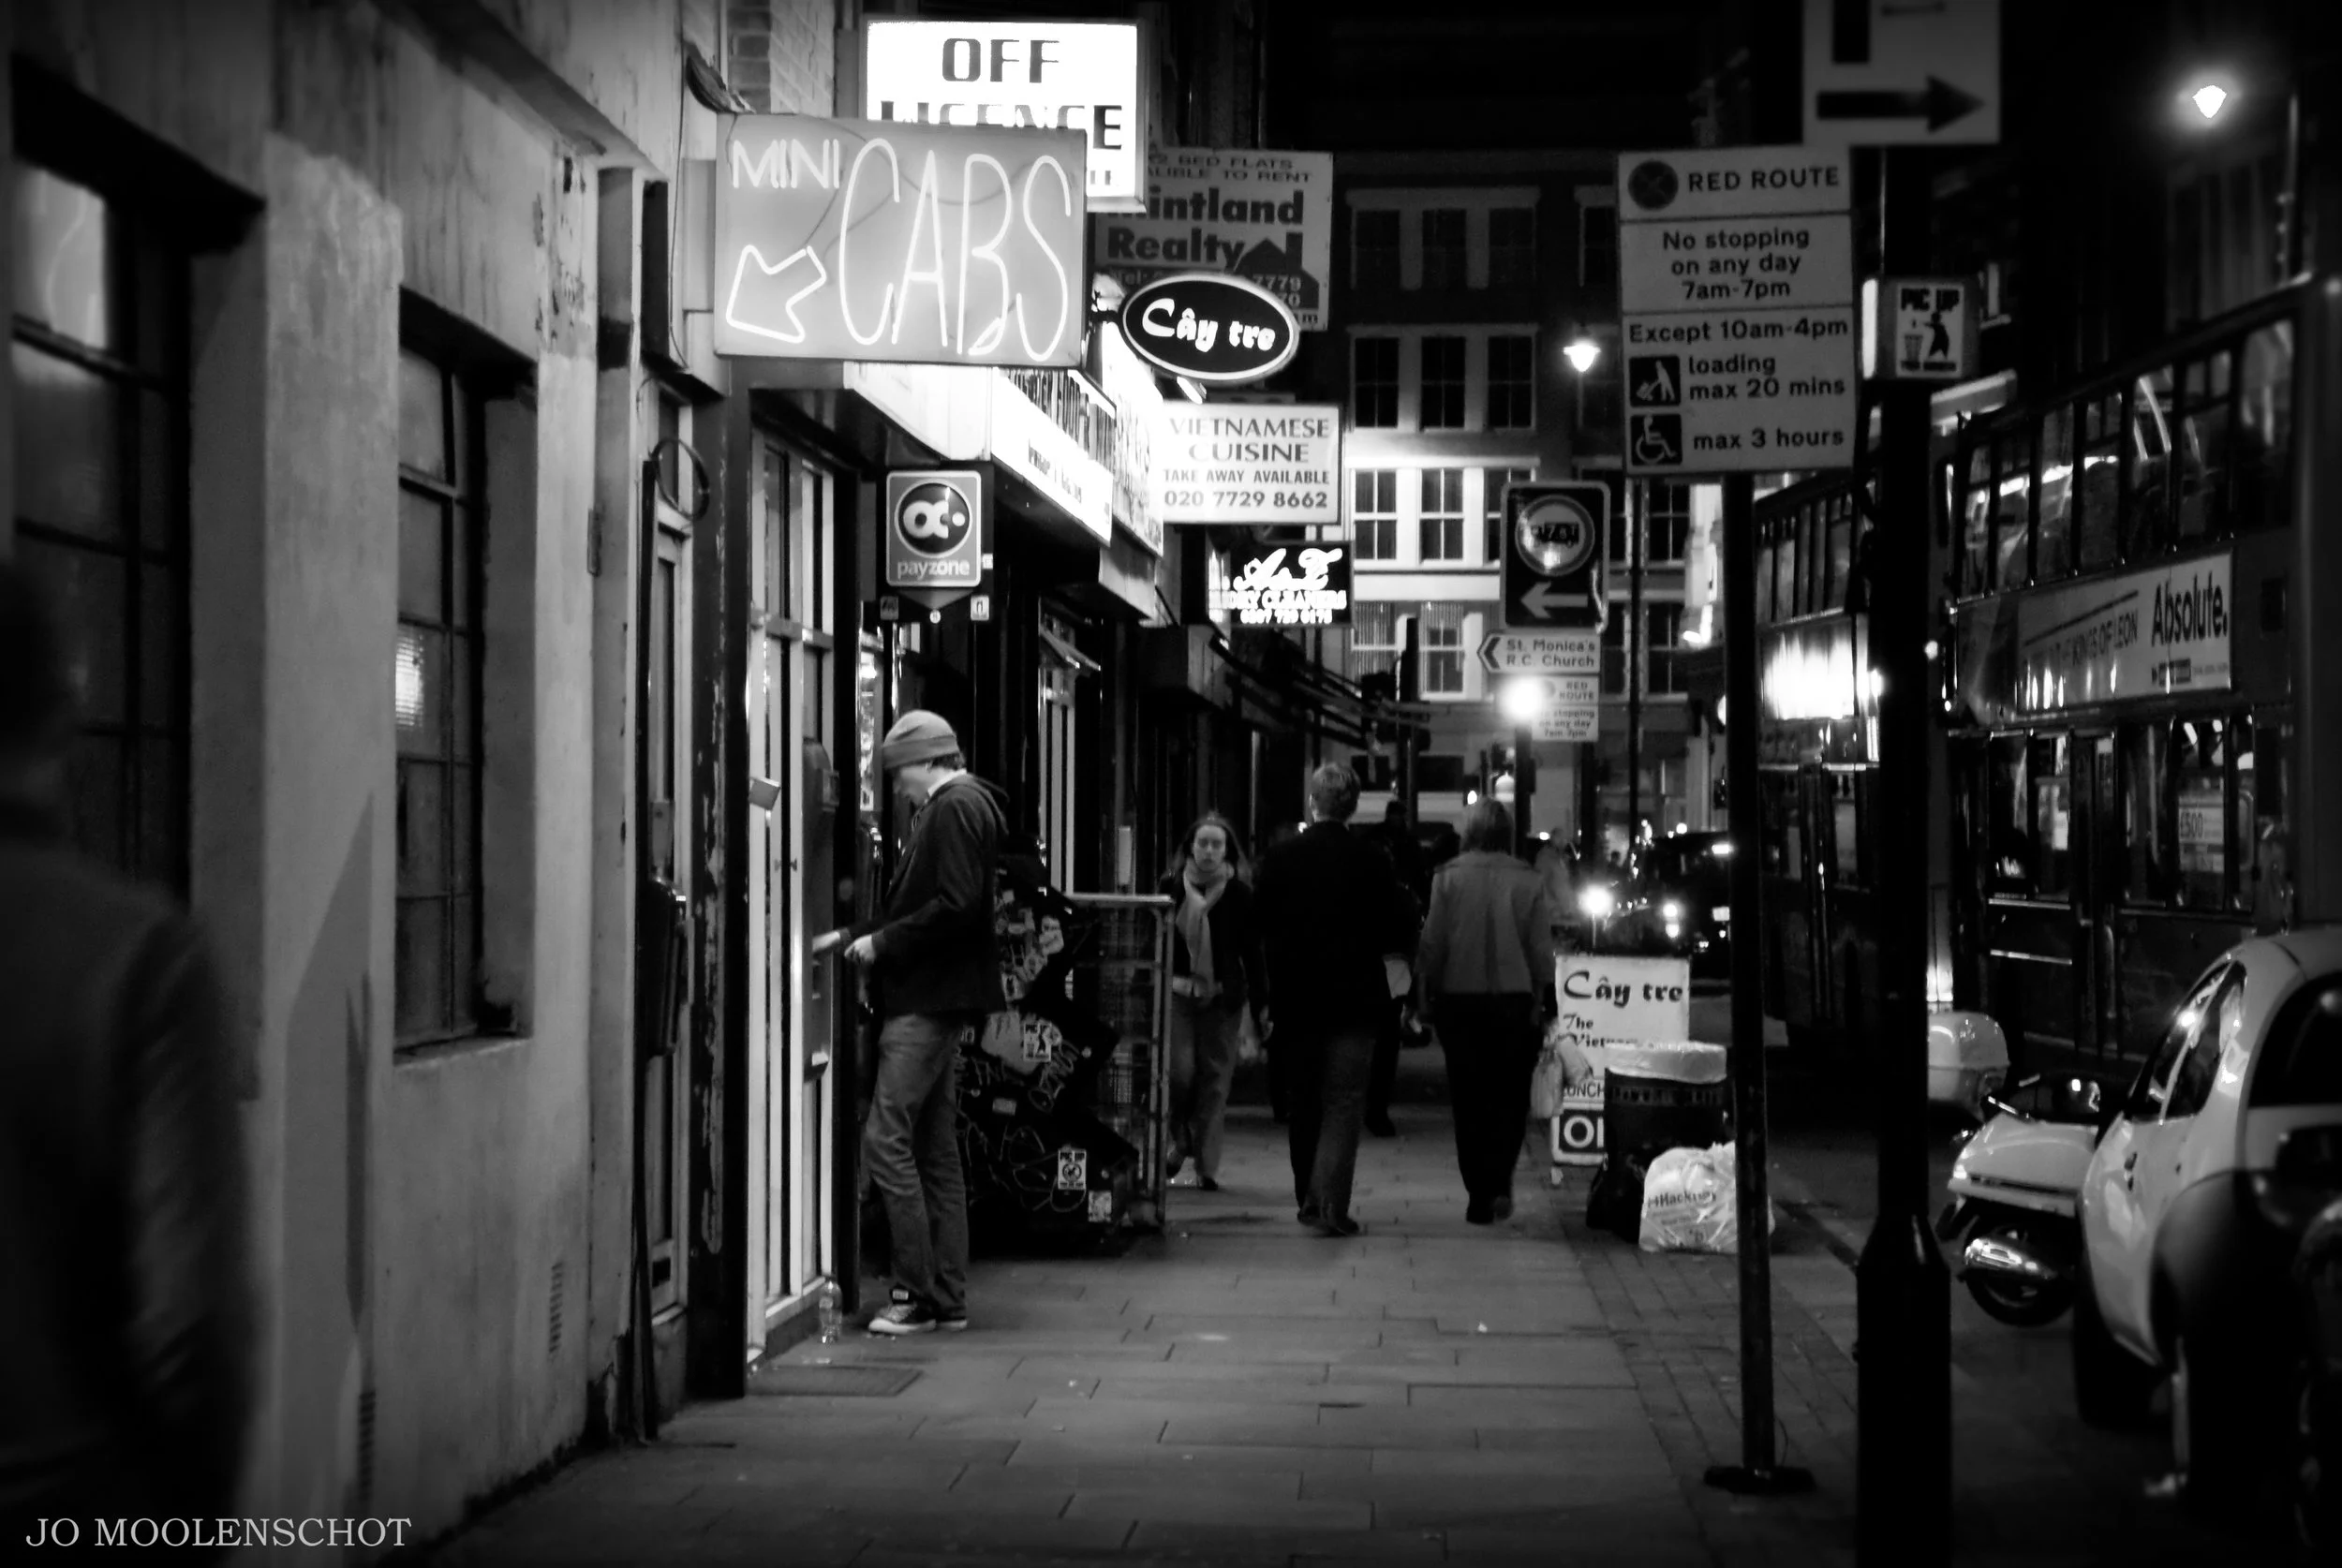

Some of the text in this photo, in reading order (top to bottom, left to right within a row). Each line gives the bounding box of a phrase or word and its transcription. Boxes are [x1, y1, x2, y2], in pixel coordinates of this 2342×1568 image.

[941, 38, 1060, 83] OFF
[733, 140, 840, 188] MINI
[1179, 155, 1221, 167] BED
[1229, 157, 1294, 169] FLATS
[1224, 170, 1248, 180] TO
[1257, 170, 1312, 183] RENT
[1687, 166, 1839, 192] RED ROUTE
[1108, 186, 1304, 224] intland
[838, 138, 1072, 362] CABS
[1107, 227, 1245, 272] Realty
[1662, 226, 1811, 252] No stopping
[1670, 252, 1801, 276] on any day
[1682, 278, 1791, 301] 7am-7pm
[1141, 297, 1277, 353] Cây tre
[1629, 318, 1848, 346] Except 10am-4pm
[1689, 353, 1776, 377] loading
[1689, 376, 1845, 401] max 20 mins
[1170, 418, 1330, 438] VIETNAMESE
[1693, 426, 1845, 450] max 3 hours
[1188, 443, 1311, 464] CUISINE
[1164, 468, 1330, 485] TAKE AWAY AVAILABLE
[1164, 489, 1328, 510] 020 7729 8662
[897, 559, 971, 581] payzone
[2151, 569, 2229, 647] Absolute.
[1533, 638, 1595, 652] Monica's
[1542, 654, 1594, 667] Church
[1566, 681, 1588, 689] RED
[1564, 970, 1684, 1008] Cây tre
[1563, 1013, 1593, 1029] The
